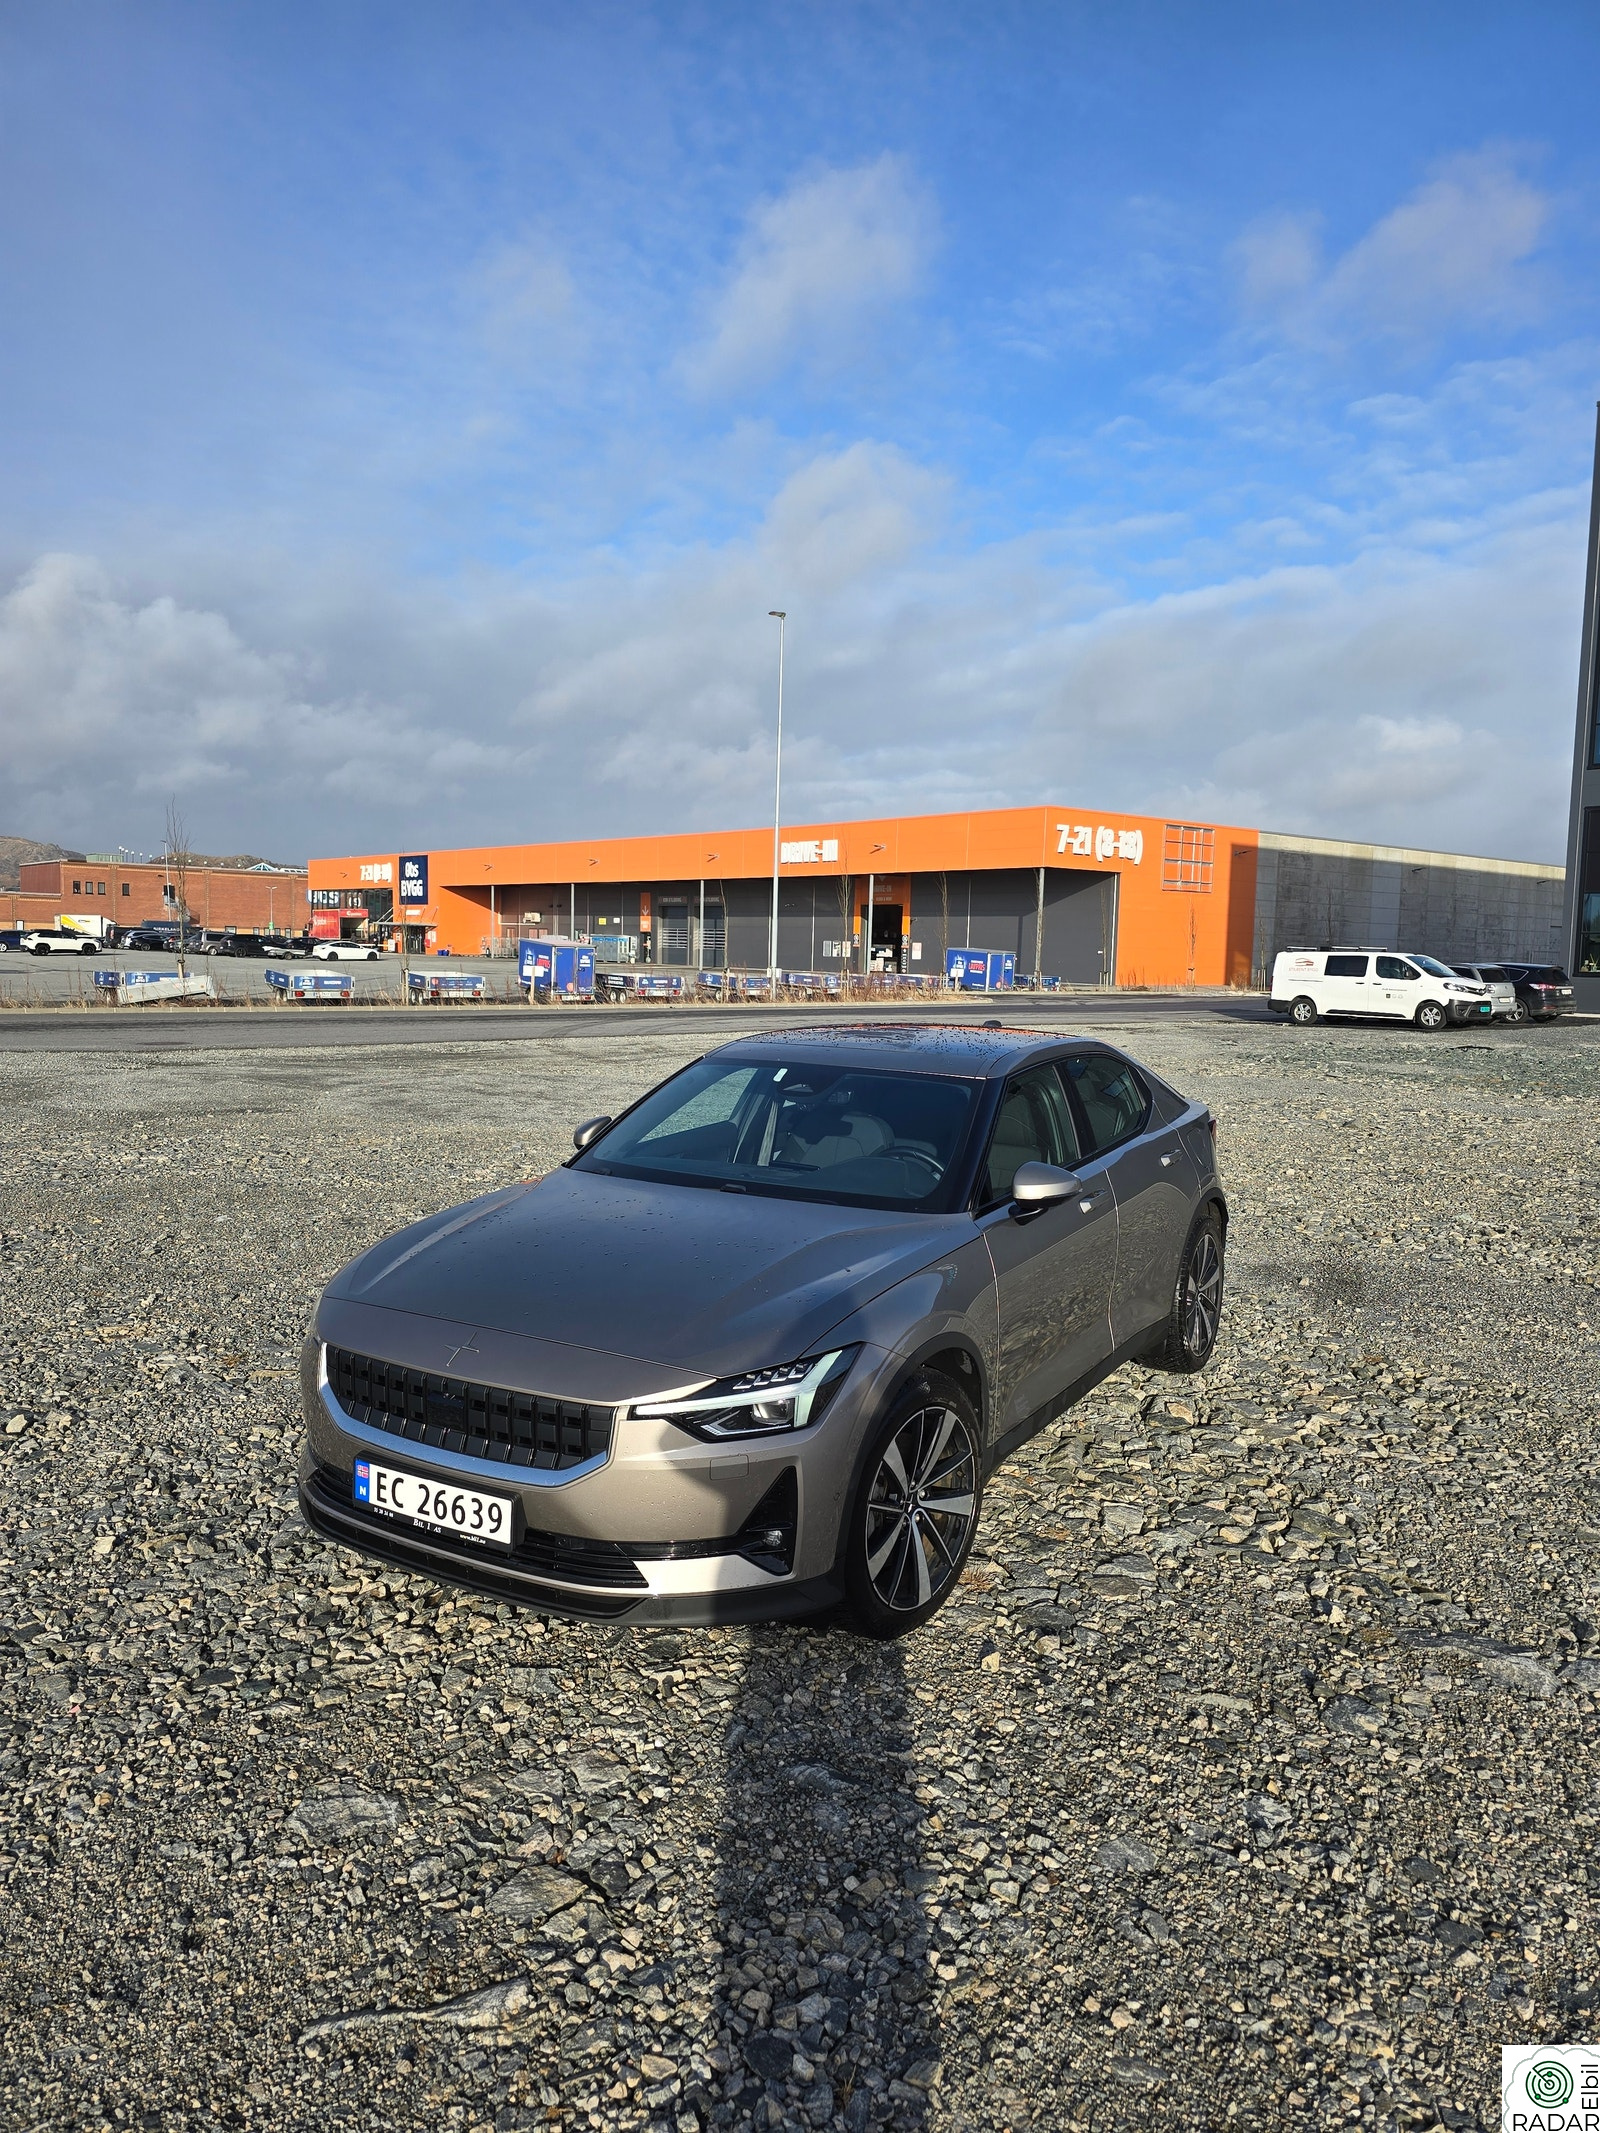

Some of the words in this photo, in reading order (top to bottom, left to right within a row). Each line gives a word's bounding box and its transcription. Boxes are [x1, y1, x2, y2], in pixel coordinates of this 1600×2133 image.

[780, 839, 839, 864] DRIVE-IN
[1056, 823, 1092, 856] 7-21
[1095, 825, 1144, 866] (8-18)
[400, 879, 424, 897] BYGG
[359, 1485, 367, 1497] N
[375, 1471, 405, 1509] EC
[416, 1483, 503, 1534] 26639
[426, 1522, 431, 1531] 1
